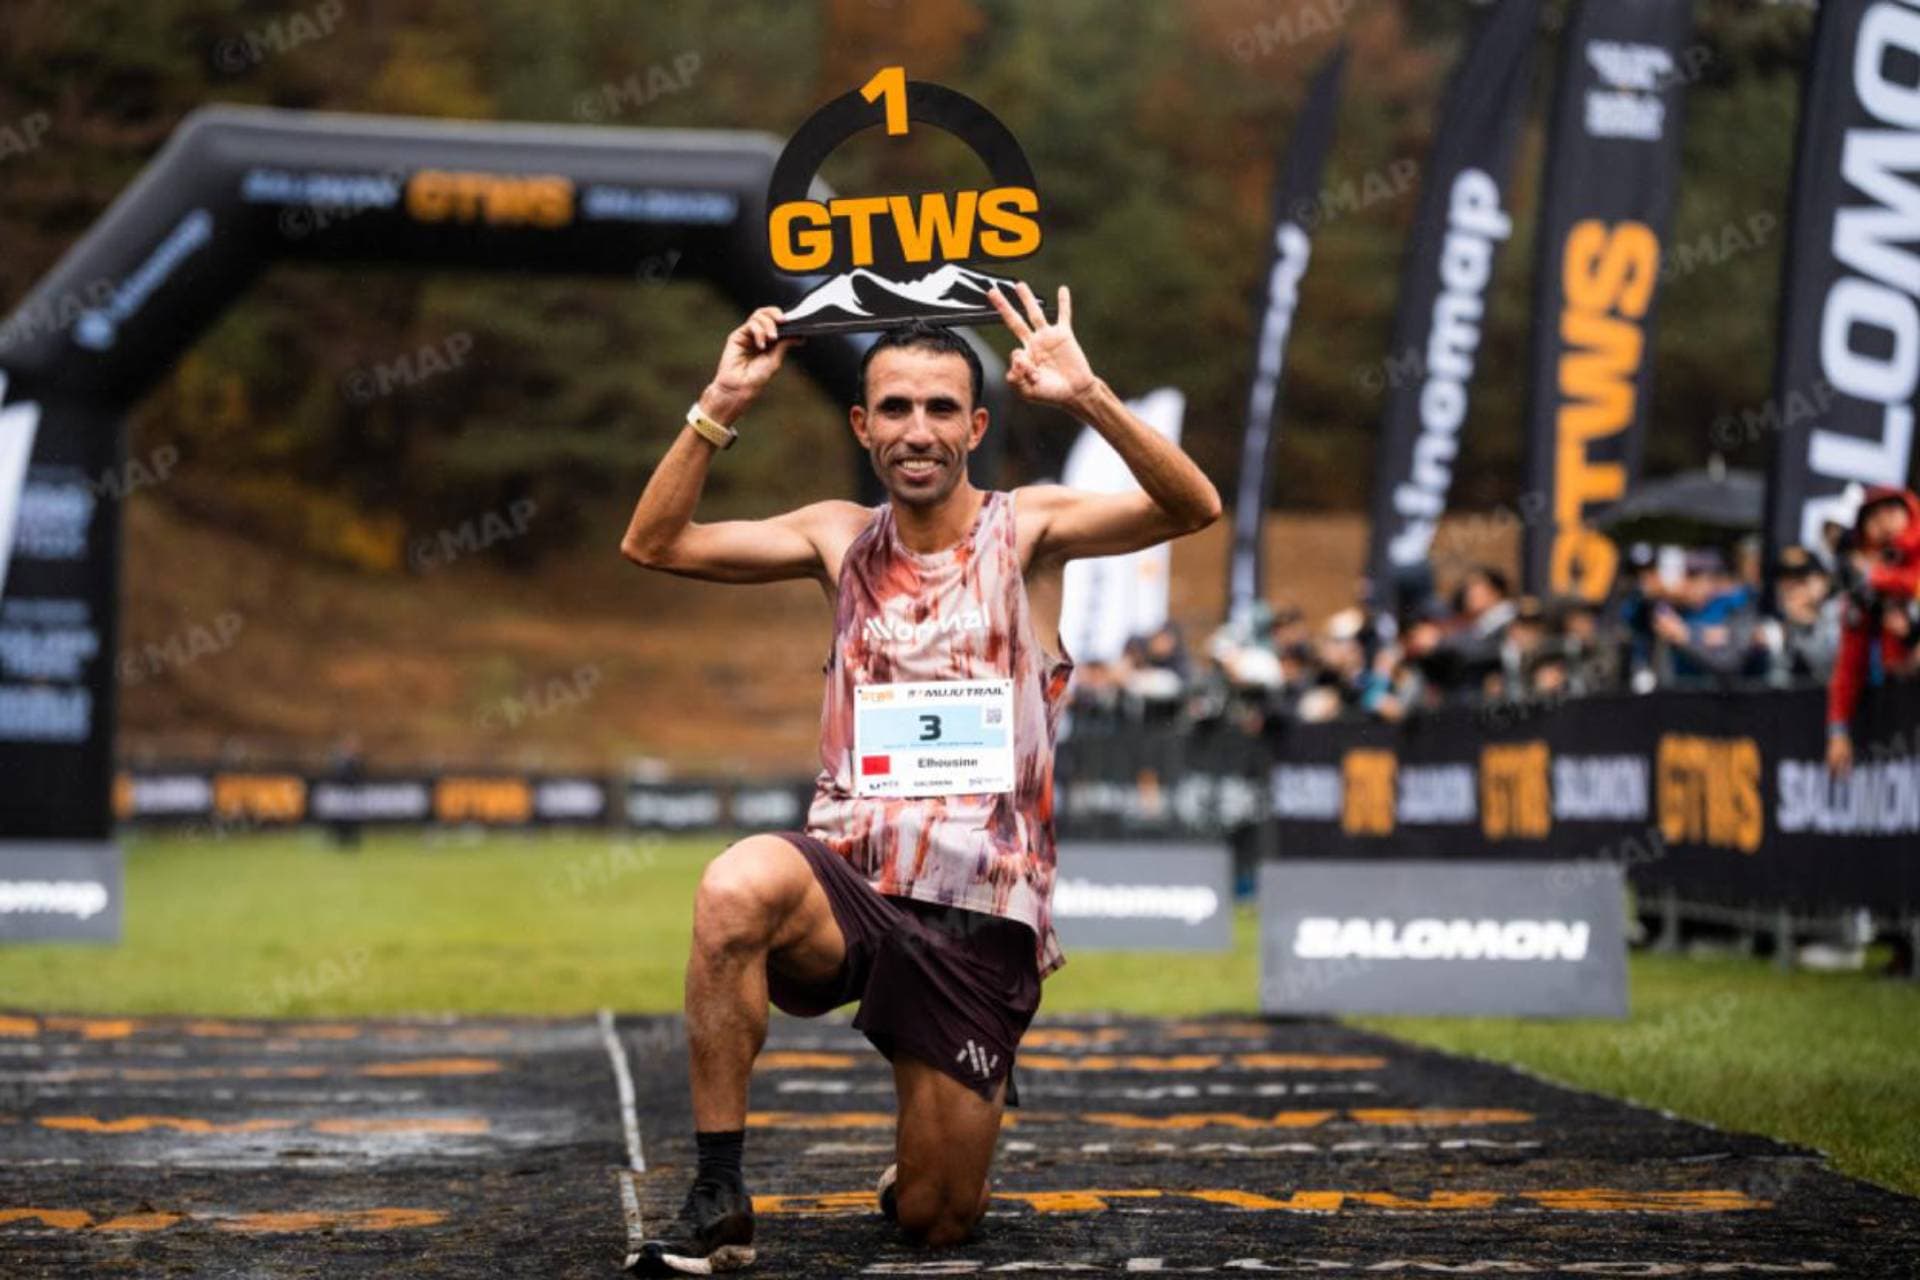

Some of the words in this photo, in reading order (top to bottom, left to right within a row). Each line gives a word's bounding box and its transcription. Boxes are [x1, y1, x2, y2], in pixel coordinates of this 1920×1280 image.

[860, 67, 908, 136] 1
[768, 187, 1043, 271] GTWS
[919, 714, 942, 741] 3
[1294, 917, 1590, 961] SALOMON
